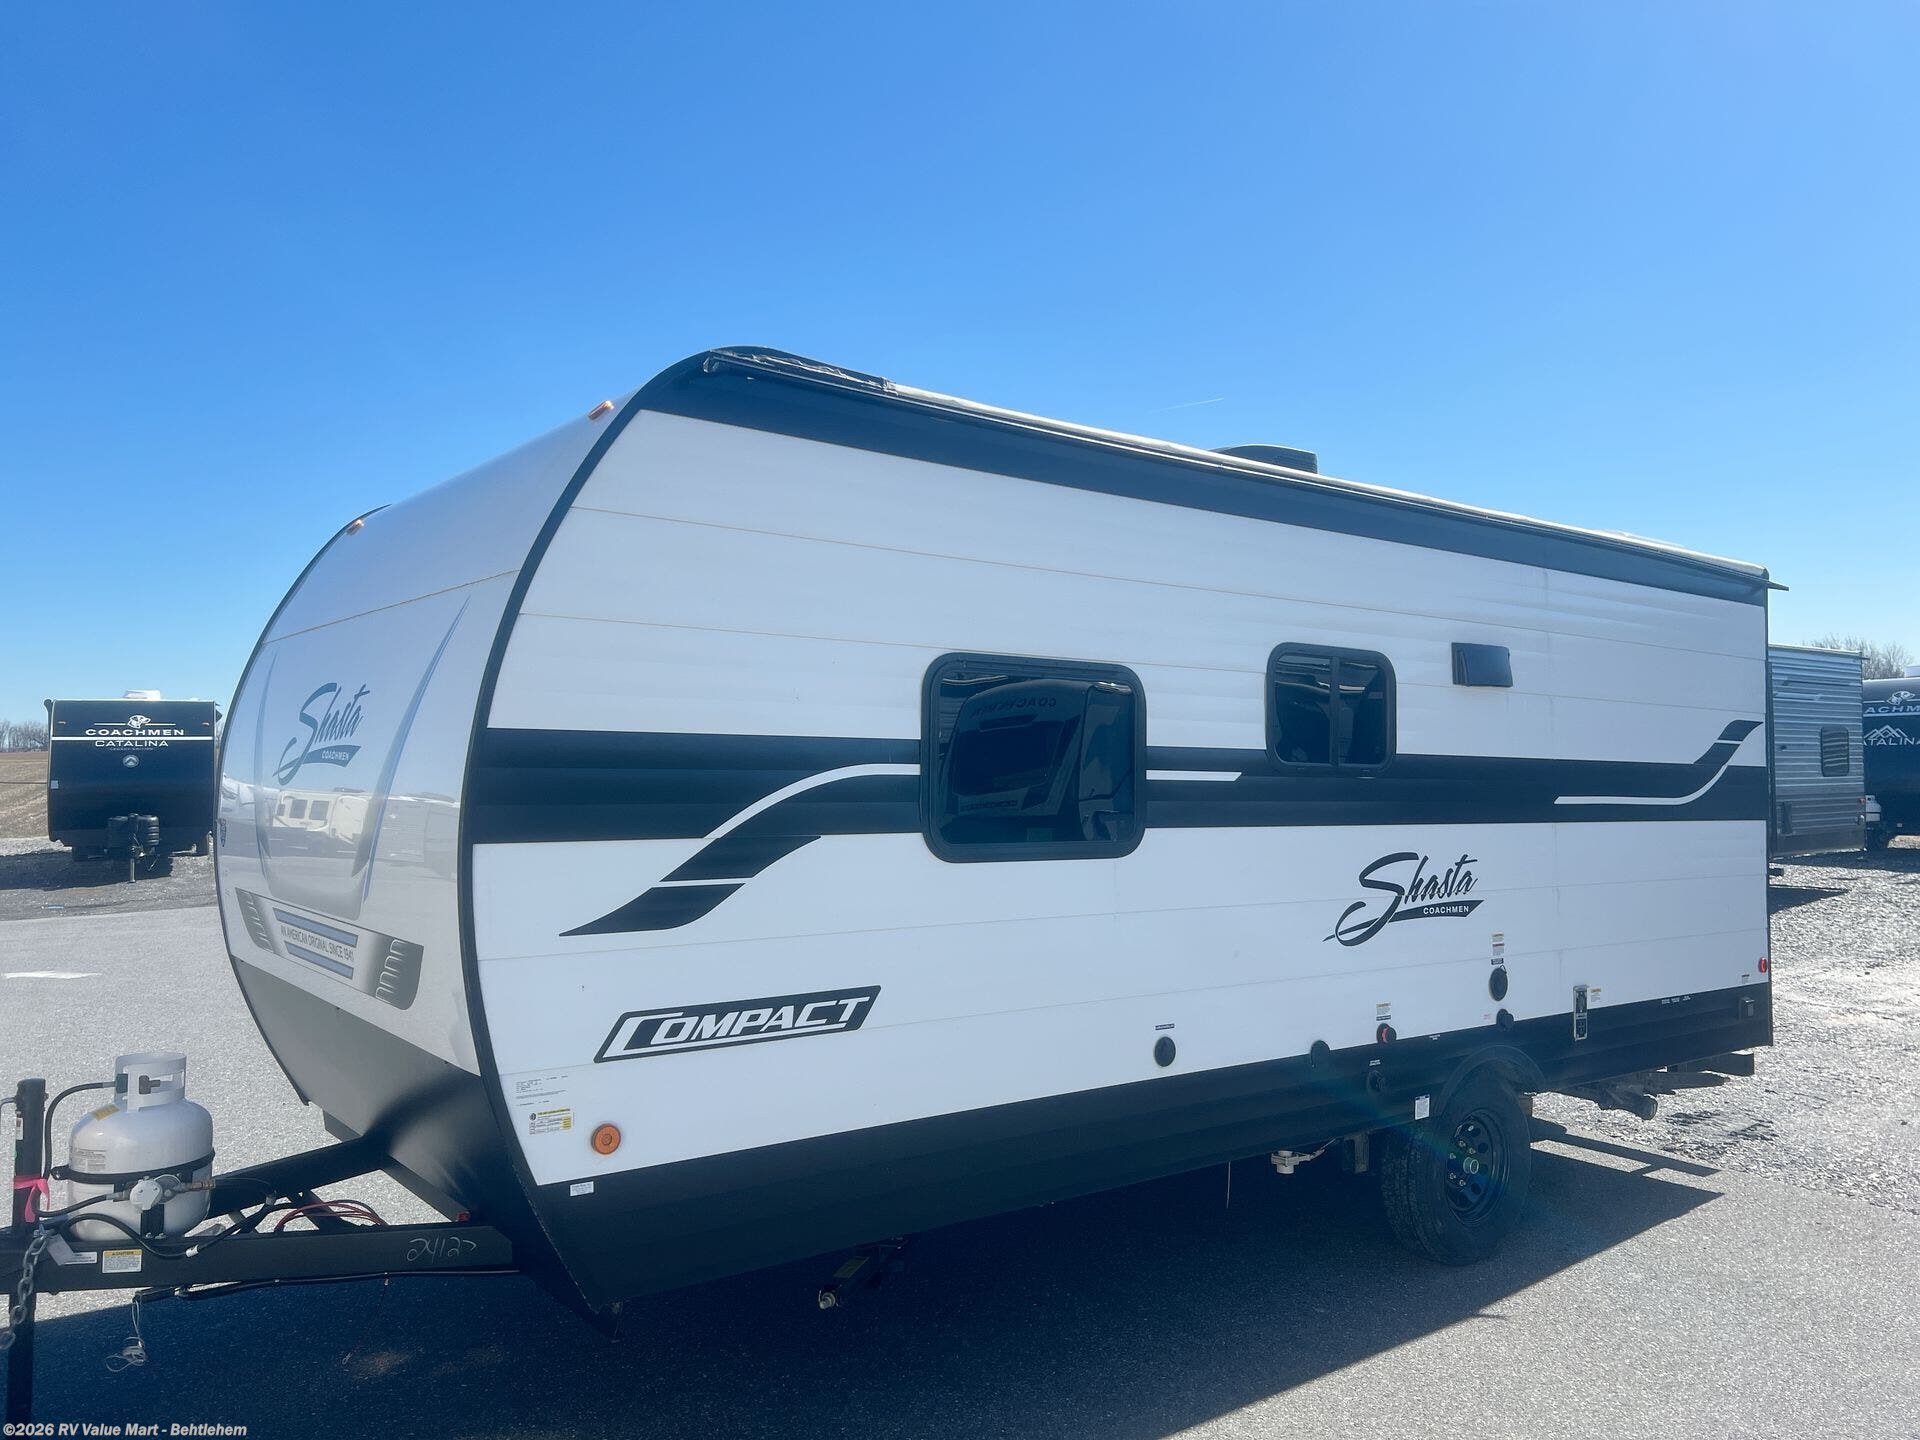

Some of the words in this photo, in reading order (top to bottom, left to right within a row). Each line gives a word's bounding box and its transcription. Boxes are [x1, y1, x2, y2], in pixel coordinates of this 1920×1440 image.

[278, 682, 370, 786] Shasta
[321, 750, 349, 761] COACHMEN
[1335, 851, 1479, 947] Shasta
[1423, 905, 1470, 915] COACHMEN
[602, 996, 870, 1058] COMPACT
